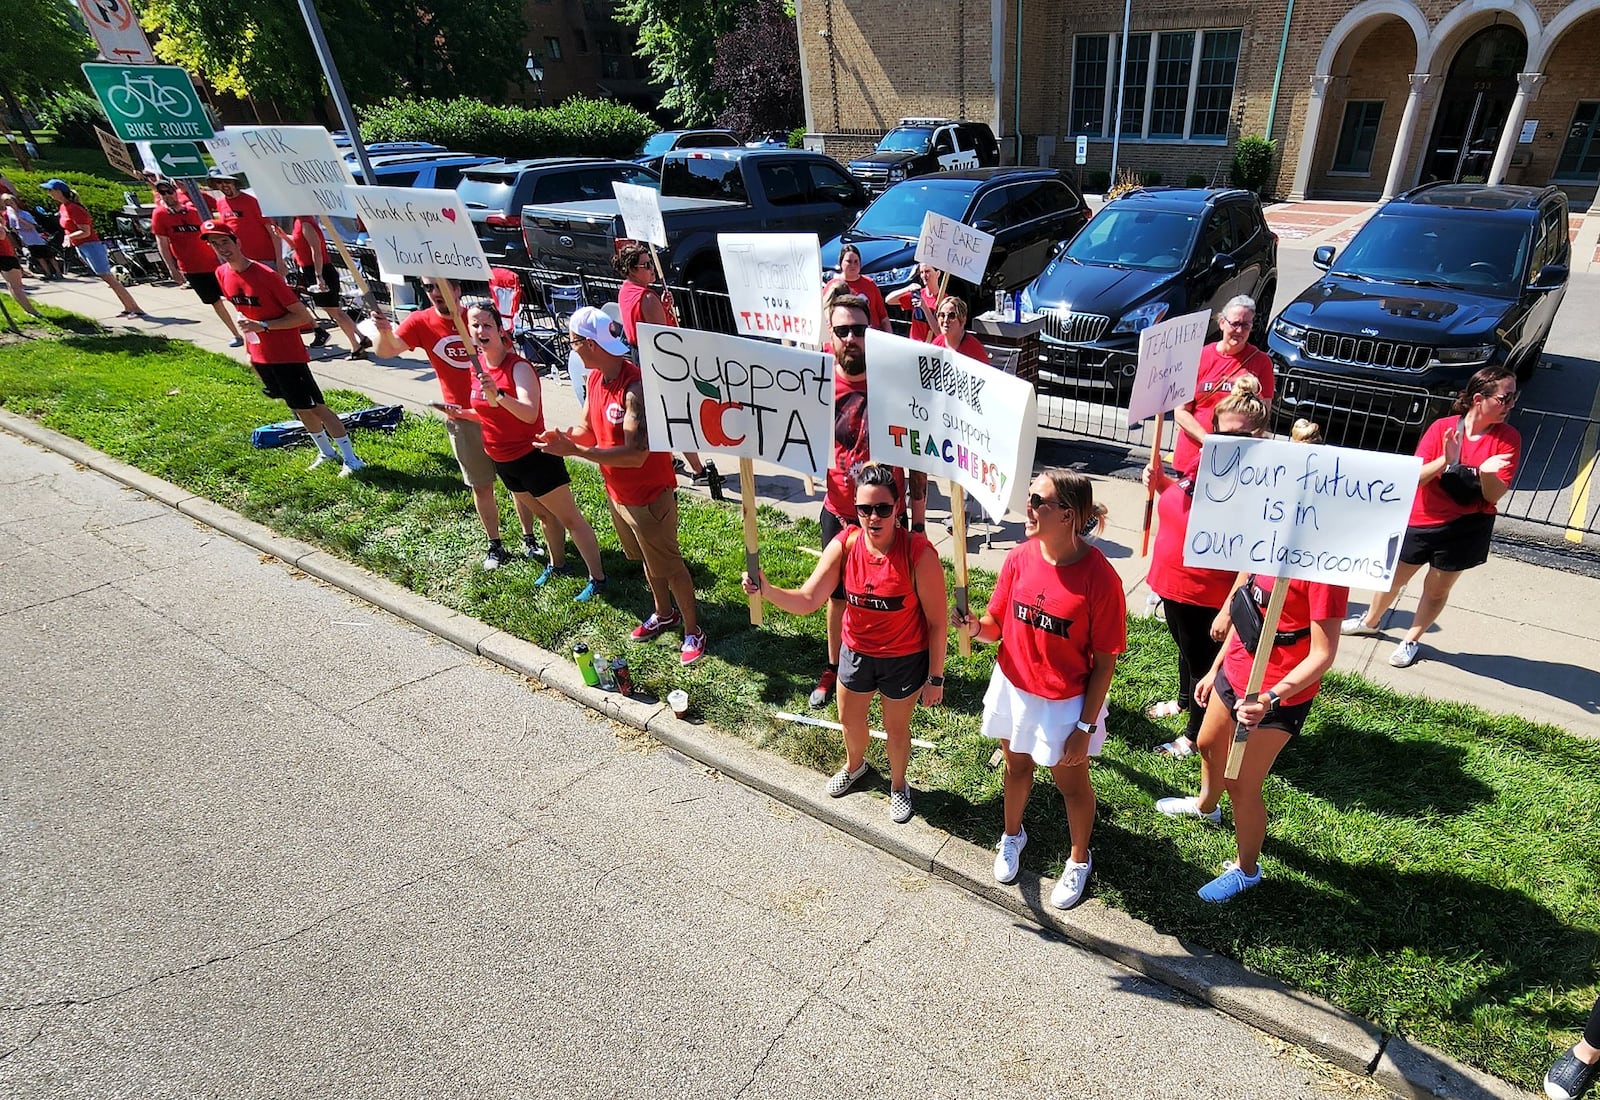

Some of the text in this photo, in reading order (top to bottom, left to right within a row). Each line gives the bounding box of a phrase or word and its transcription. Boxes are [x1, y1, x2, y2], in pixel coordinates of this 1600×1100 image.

[125, 122, 203, 137] BIKE ROUTE
[242, 128, 298, 159] FAIR
[355, 195, 443, 227] Honk if you
[385, 235, 483, 269] Your Teachers
[929, 214, 983, 253] WE CARE
[924, 236, 978, 275] BE FAIR
[763, 296, 791, 310] YOUR
[740, 311, 813, 336] TEACHERS
[1146, 322, 1205, 360] TEACHERS
[446, 346, 484, 357] RES
[651, 331, 831, 415] Support
[918, 356, 986, 415] HONK
[1162, 382, 1187, 406] More
[661, 391, 817, 473] HCTA
[908, 396, 991, 452] to support
[888, 425, 1007, 501] TEACHERS!
[1206, 444, 1401, 502] Your future
[1263, 498, 1319, 530] is in
[1192, 530, 1402, 580] our classrooms!
